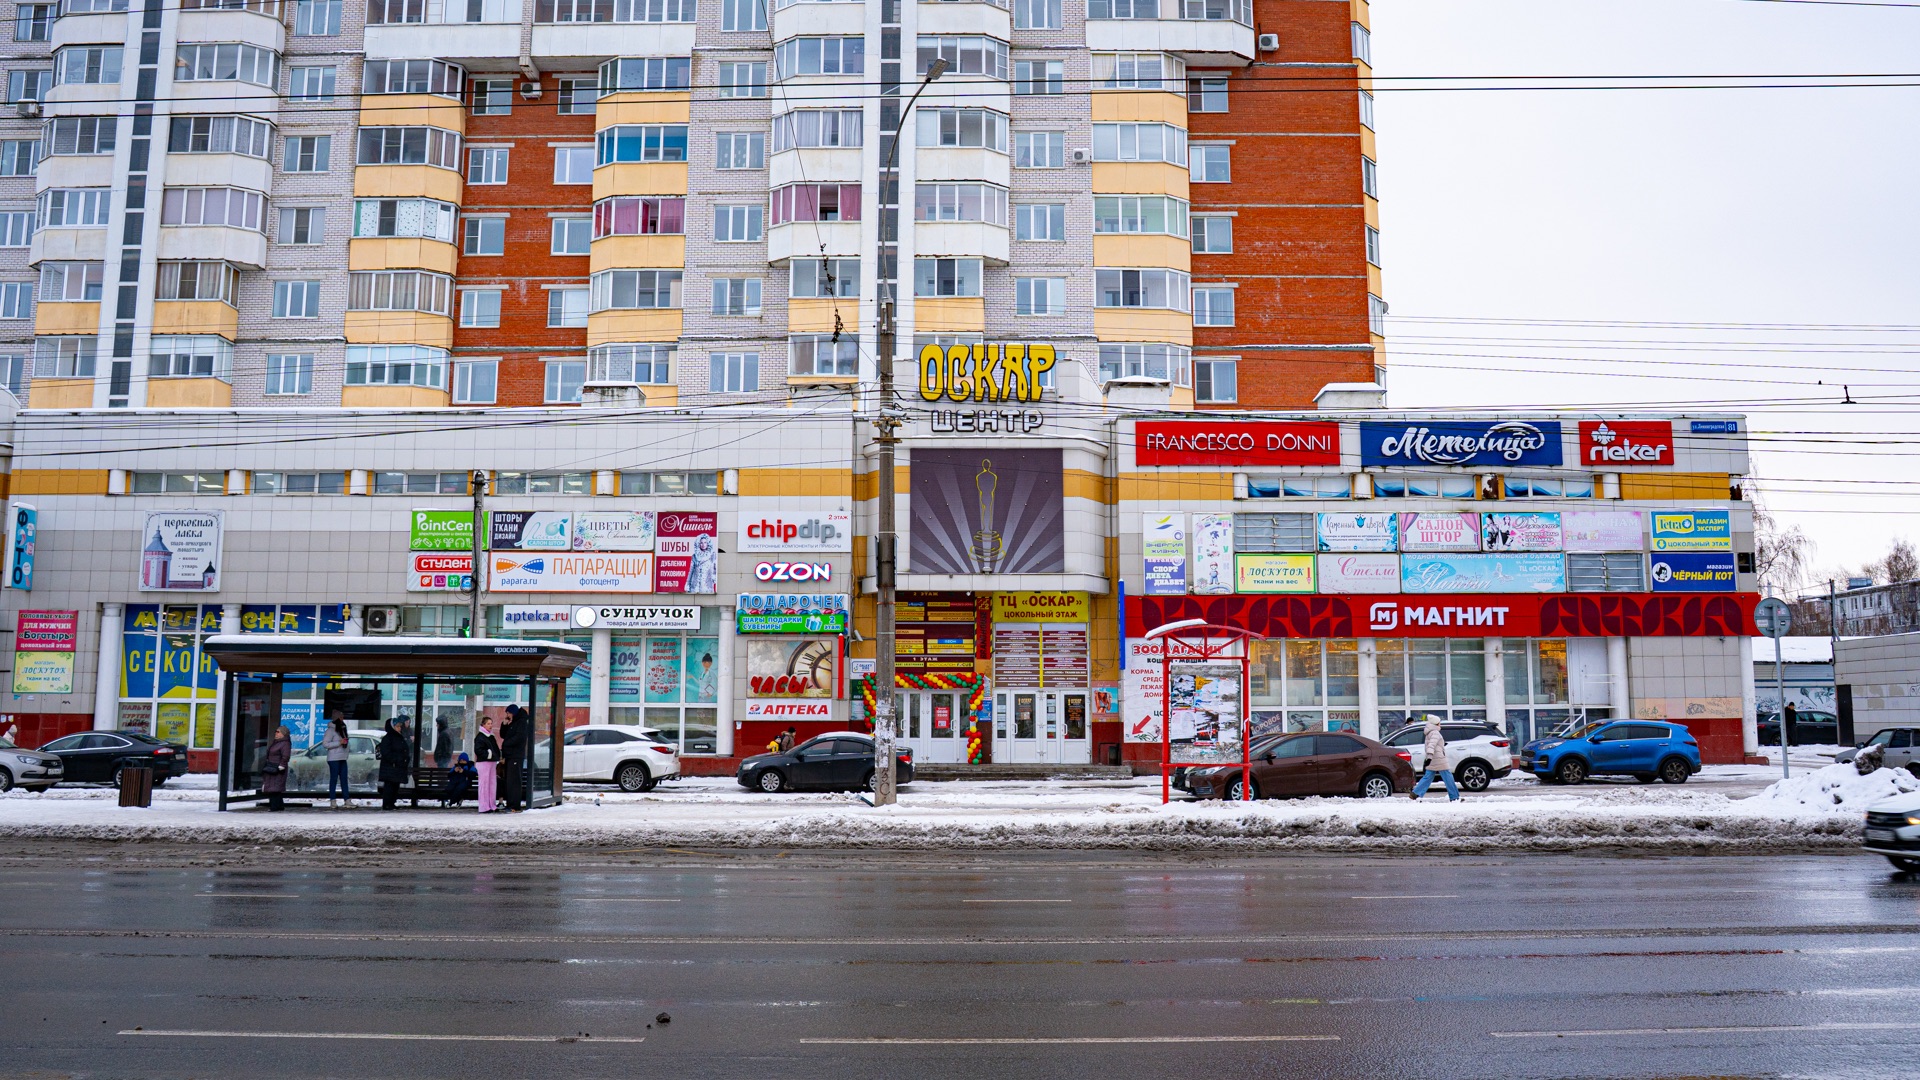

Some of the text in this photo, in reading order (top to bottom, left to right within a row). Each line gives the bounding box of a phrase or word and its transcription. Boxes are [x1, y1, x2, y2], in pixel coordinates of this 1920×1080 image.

[919, 343, 1056, 402] ОСКАР
[931, 409, 1043, 432] ЦЕНТР
[1727, 423, 1736, 431] 81
[1146, 433, 1331, 451] FRANCESCO DONNI
[1381, 422, 1545, 464] Метелица
[1590, 438, 1668, 461] rieker
[416, 512, 473, 531] PointCen
[494, 513, 522, 523] ШТОРЫ
[1657, 518, 1682, 530] Tetra
[494, 524, 518, 532] ТКАНИ
[590, 521, 630, 531] ЦВЕТЫ
[1416, 519, 1465, 531] САЛОН
[493, 532, 516, 540] ДИЗАЙН
[1420, 531, 1462, 543] ШТОР
[661, 541, 690, 552] ШУБЫ
[1667, 540, 1710, 548] ЦОКОЛЬНЫЙ
[553, 558, 647, 578] ПАПАРАЦЦИ
[754, 562, 832, 582] OZON
[1247, 567, 1304, 576] ЛОСКУТОК
[1338, 557, 1396, 576] Стелла
[1672, 569, 1734, 580] ЧЁРНЫЙ КОТ
[501, 578, 538, 587] papara.ru
[579, 578, 620, 587] фотоцентр
[660, 580, 679, 588] ПАЛЬТО
[1154, 579, 1185, 587] ДИАБЕТ
[740, 595, 844, 609] ПОДАРОЧЕК
[999, 595, 1082, 608] ТЦ «ОСКАР»
[505, 610, 569, 624] apteka.ru
[600, 607, 695, 619] СУНДУЧОК
[1004, 610, 1053, 618] ЦОКОЛЬНЫЙ
[1404, 606, 1510, 626] МАГНИТ
[133, 611, 298, 629] МЕГАЕНД
[18, 630, 75, 641] «Богатырь»
[129, 650, 218, 676] СЕКОН
[22, 667, 67, 675] ЛОСКУТОК
[750, 675, 808, 694] ЧАСЫ
[763, 705, 828, 715] АПТЕКА
[1328, 712, 1360, 720] СУМКИ
